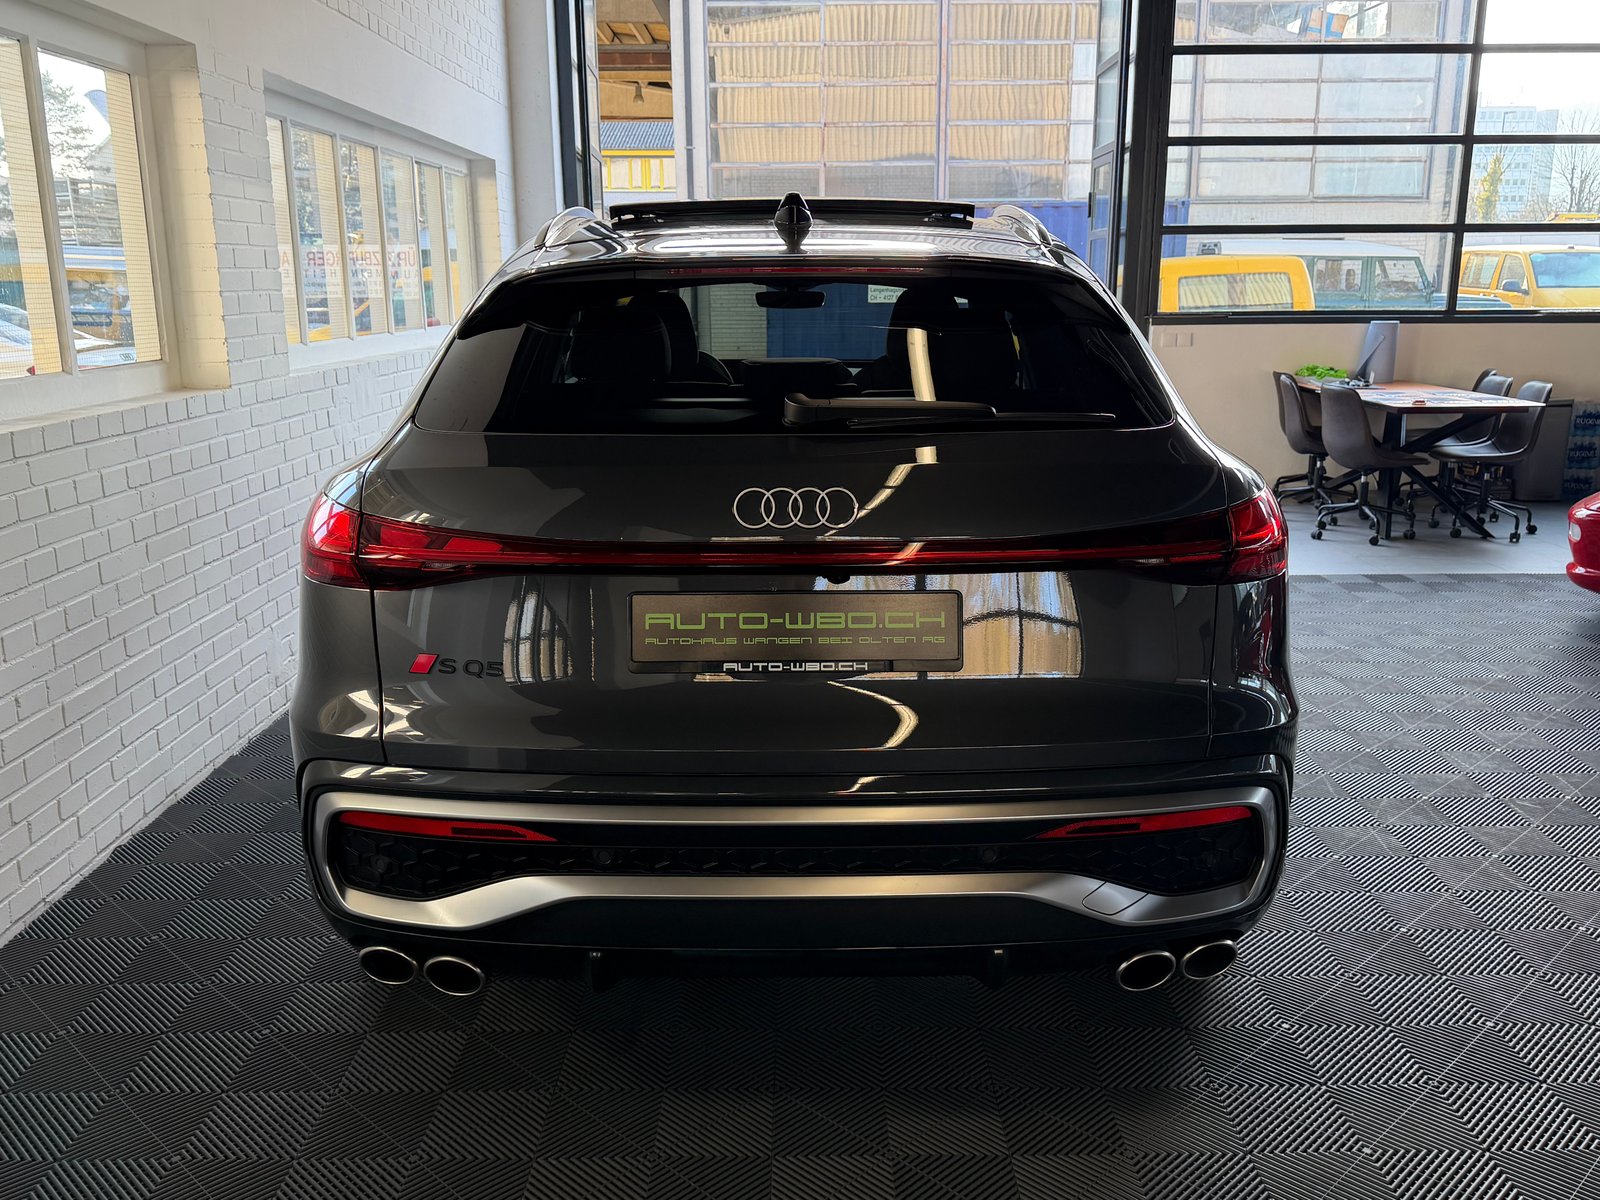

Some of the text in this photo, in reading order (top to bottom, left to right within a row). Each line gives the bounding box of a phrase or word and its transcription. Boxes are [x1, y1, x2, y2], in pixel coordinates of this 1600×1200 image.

[644, 611, 945, 630] AUTO-WBO.CH
[645, 637, 737, 645] AUTOHAUS
[743, 637, 812, 645] WANGEN
[818, 636, 852, 644] BEI
[859, 636, 916, 644] OLTEN
[723, 662, 868, 672] AUTO-WBO.CH
